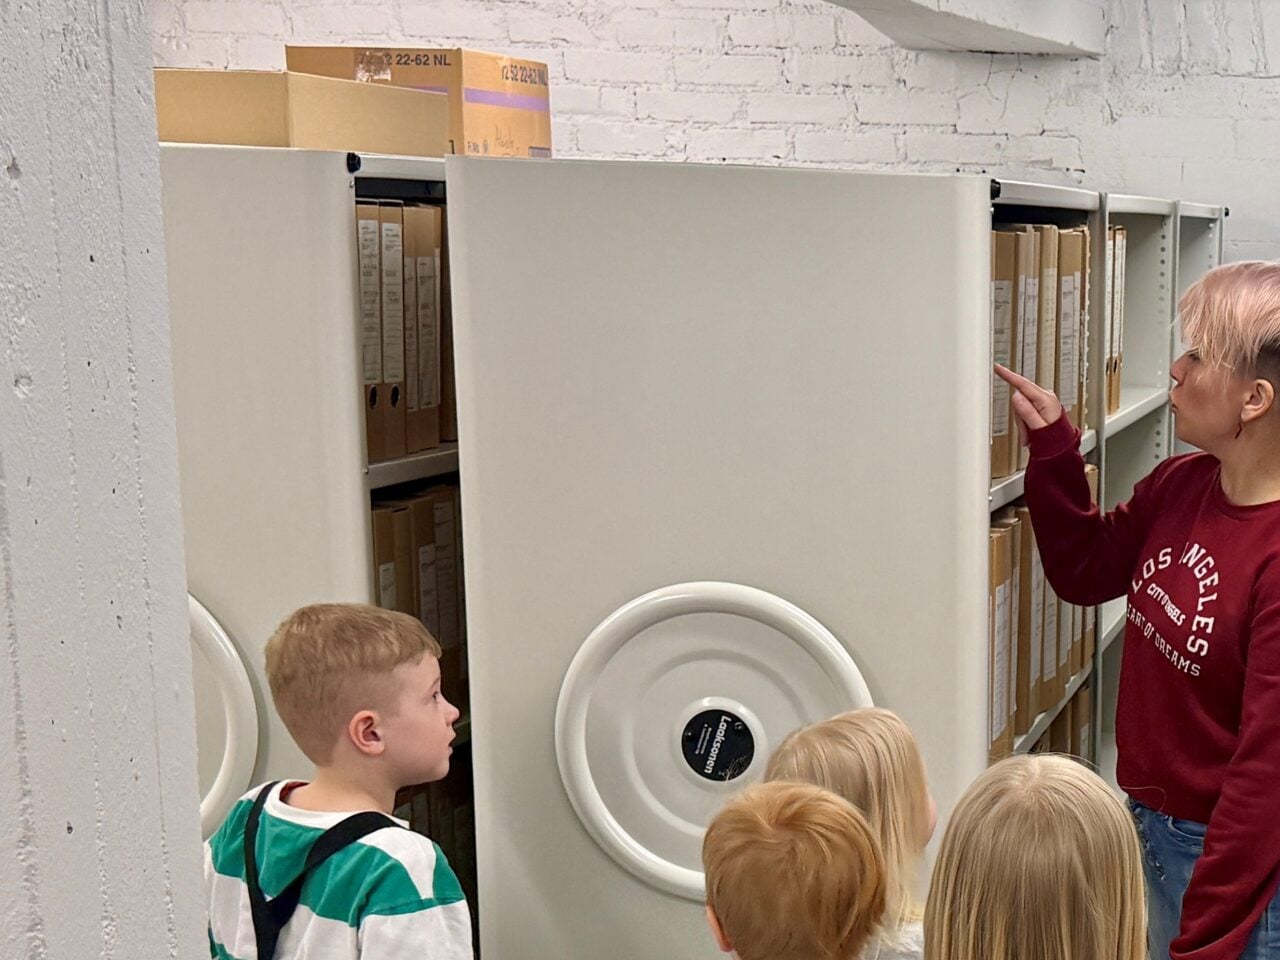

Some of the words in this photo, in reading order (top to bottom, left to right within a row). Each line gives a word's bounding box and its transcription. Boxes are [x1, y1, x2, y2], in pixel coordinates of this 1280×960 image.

[395, 53, 430, 66] 22-62
[434, 54, 451, 66] NL
[1179, 542, 1219, 657] NGELES
[1155, 633, 1201, 677] DREAMS
[704, 716, 732, 774] Laaksonen
